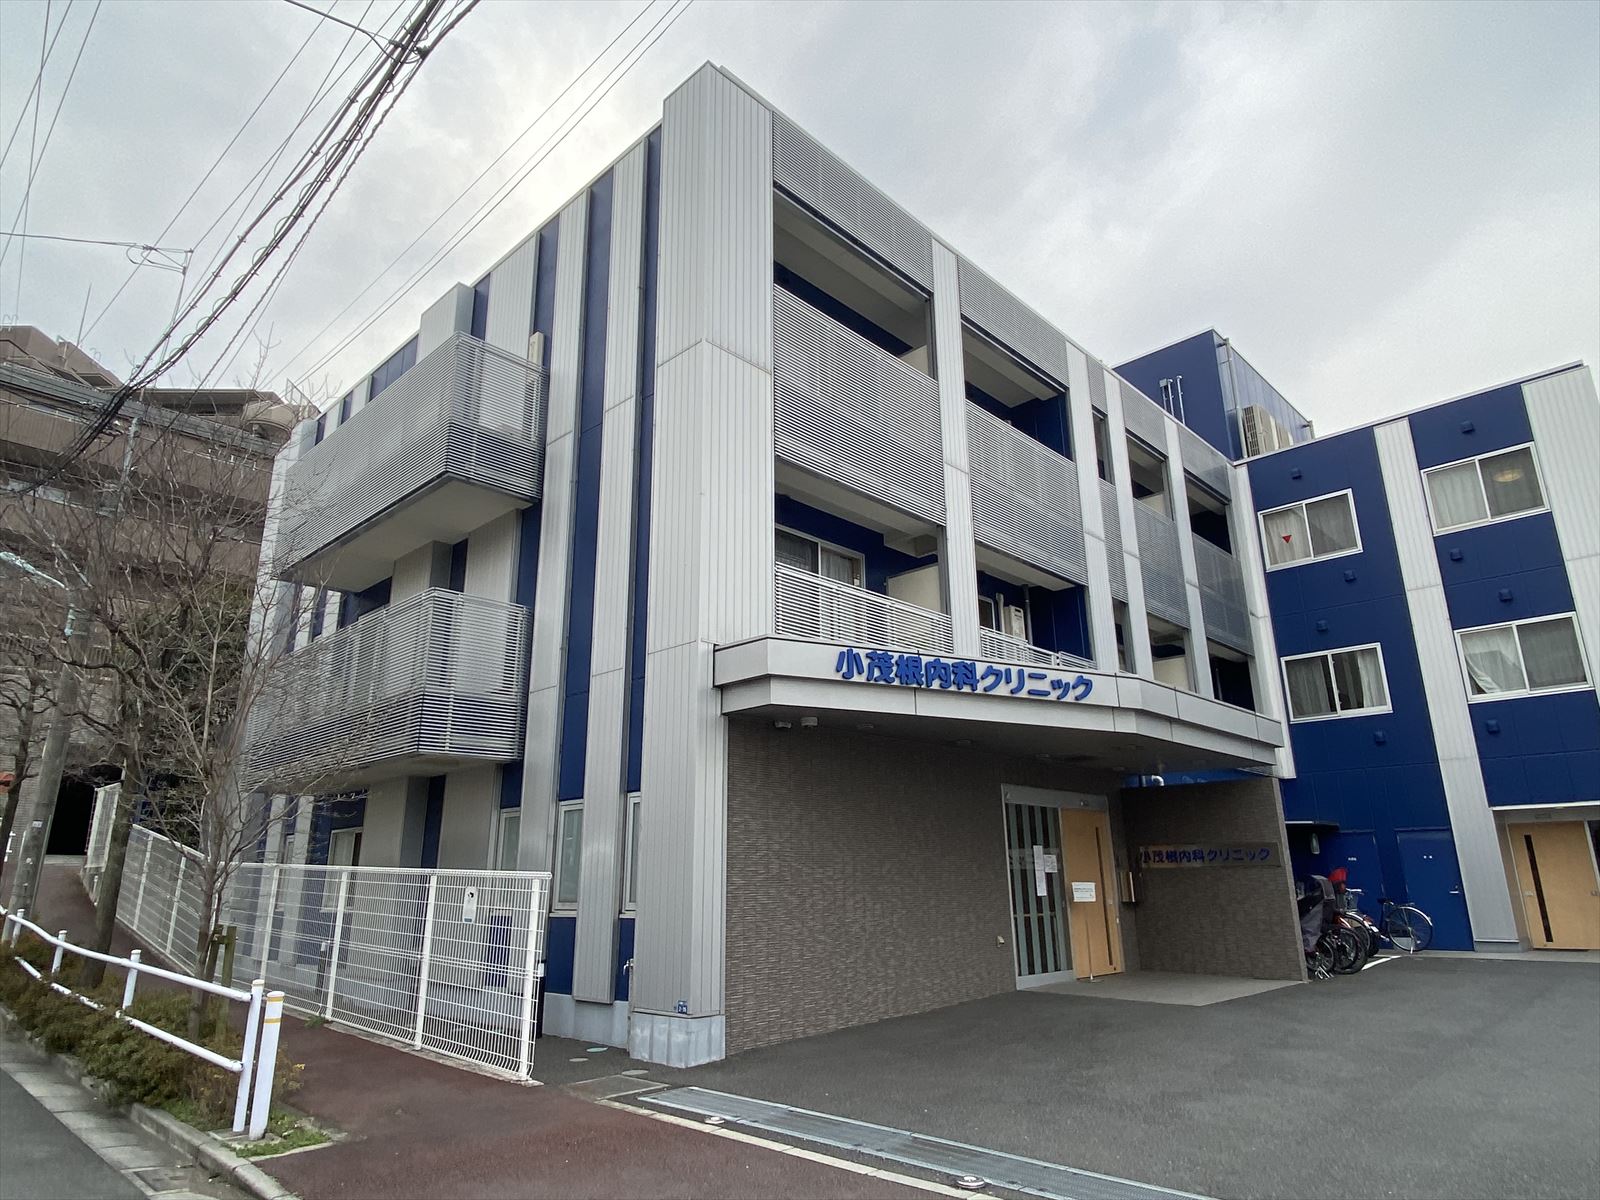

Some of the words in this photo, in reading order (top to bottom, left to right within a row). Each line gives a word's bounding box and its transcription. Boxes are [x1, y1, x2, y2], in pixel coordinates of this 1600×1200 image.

[836, 648, 1093, 700] 小茂根内科クリニック
